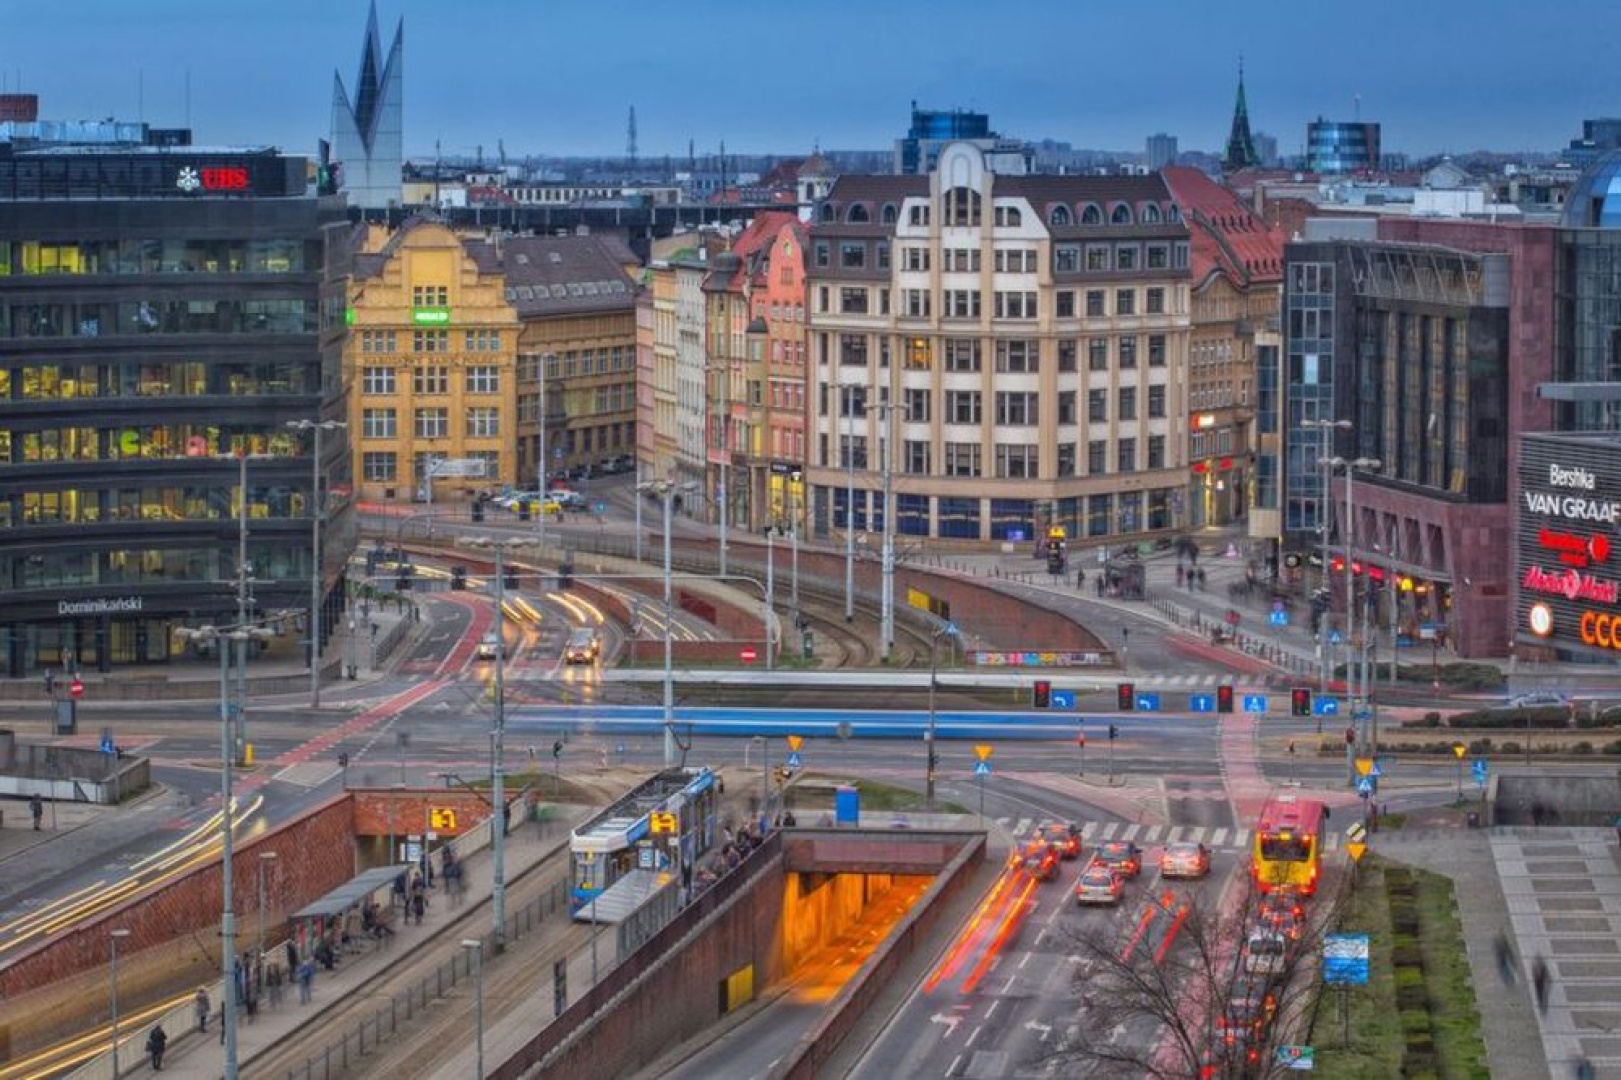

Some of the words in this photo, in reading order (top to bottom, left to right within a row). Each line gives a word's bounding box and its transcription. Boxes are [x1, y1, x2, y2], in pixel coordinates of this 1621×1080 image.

[1549, 463, 1595, 489] Bershka
[1525, 491, 1560, 515] VAN
[1562, 497, 1621, 522] GRAAF
[58, 596, 142, 614] Dominikański
[1581, 611, 1621, 648] CCC
